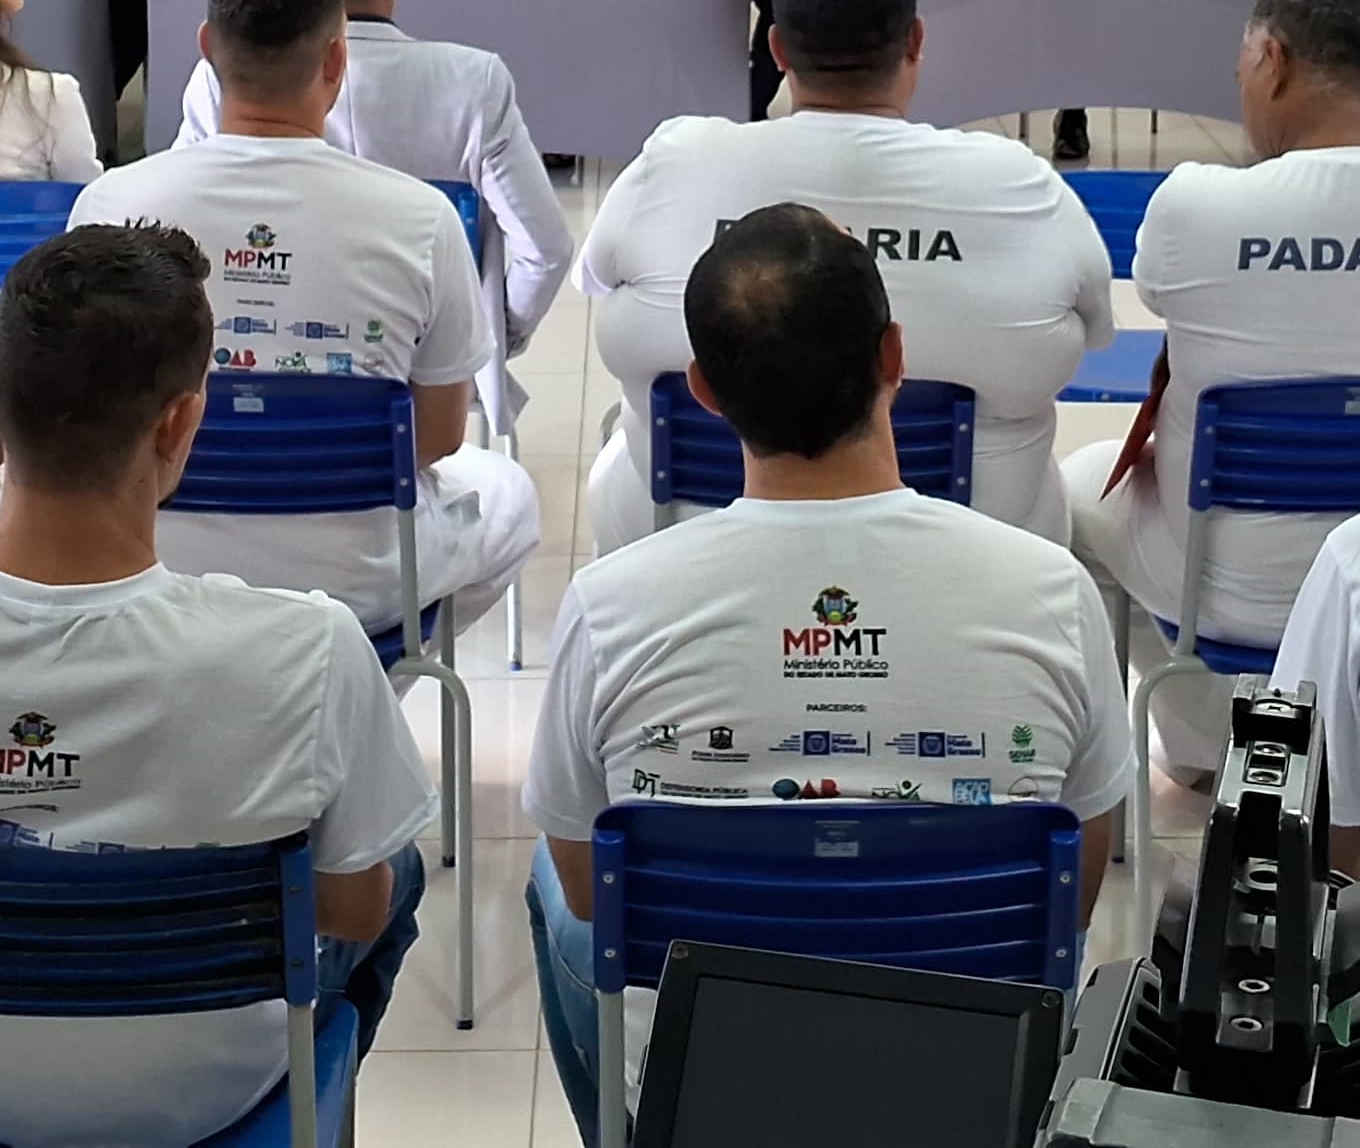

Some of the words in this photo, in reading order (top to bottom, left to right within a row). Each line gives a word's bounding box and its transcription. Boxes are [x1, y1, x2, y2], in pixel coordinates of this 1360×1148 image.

[224, 248, 292, 270] MPMT
[783, 628, 887, 656] MPMT
[784, 658, 840, 670] Ministério
[843, 658, 889, 670] Público
